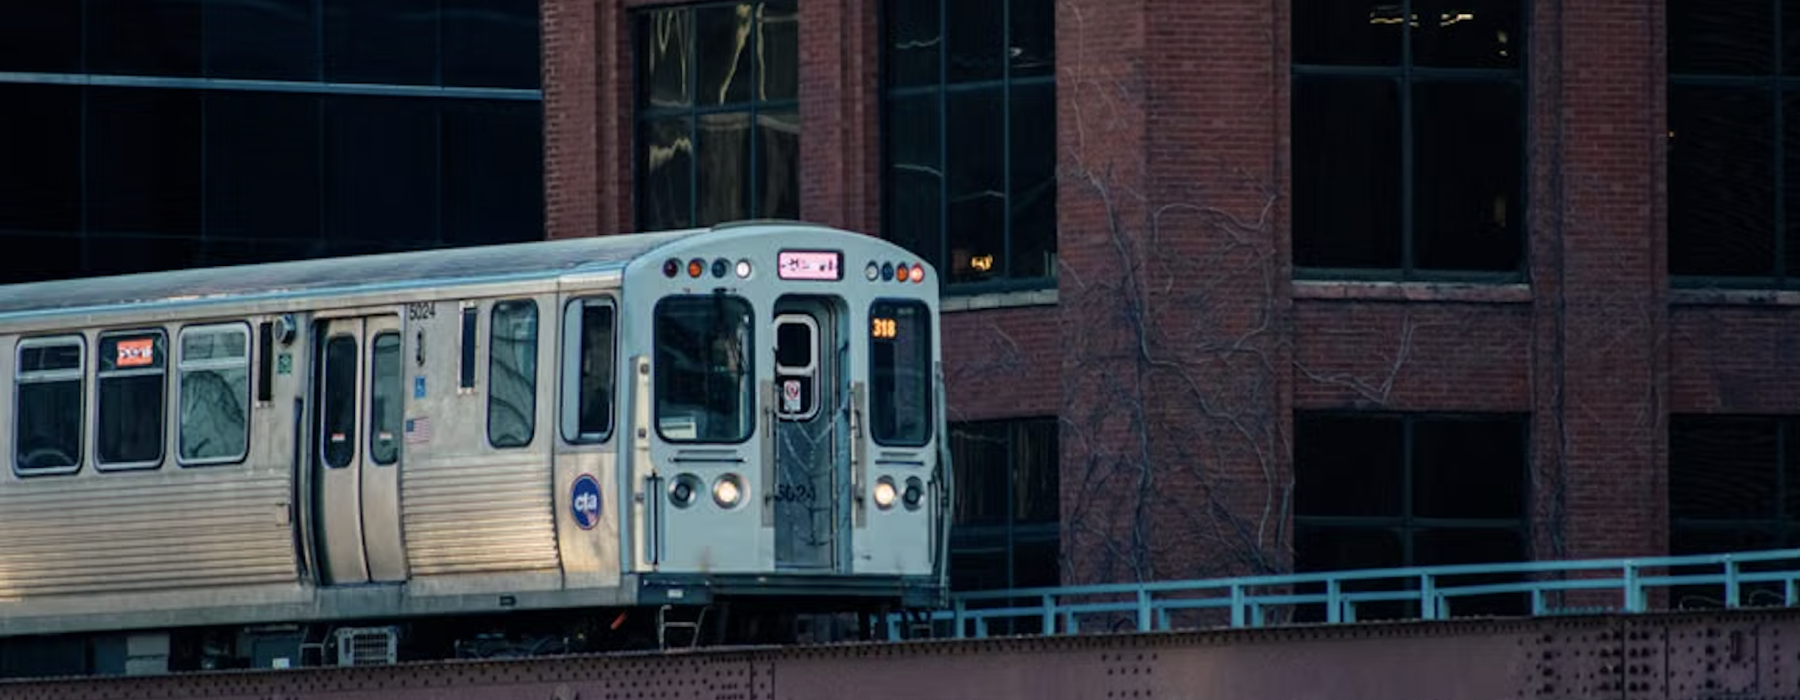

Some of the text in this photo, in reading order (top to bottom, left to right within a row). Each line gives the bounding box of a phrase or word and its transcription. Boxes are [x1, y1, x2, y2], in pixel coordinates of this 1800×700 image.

[409, 301, 436, 320] 5024
[873, 317, 896, 338] 318
[574, 491, 598, 512] cta
